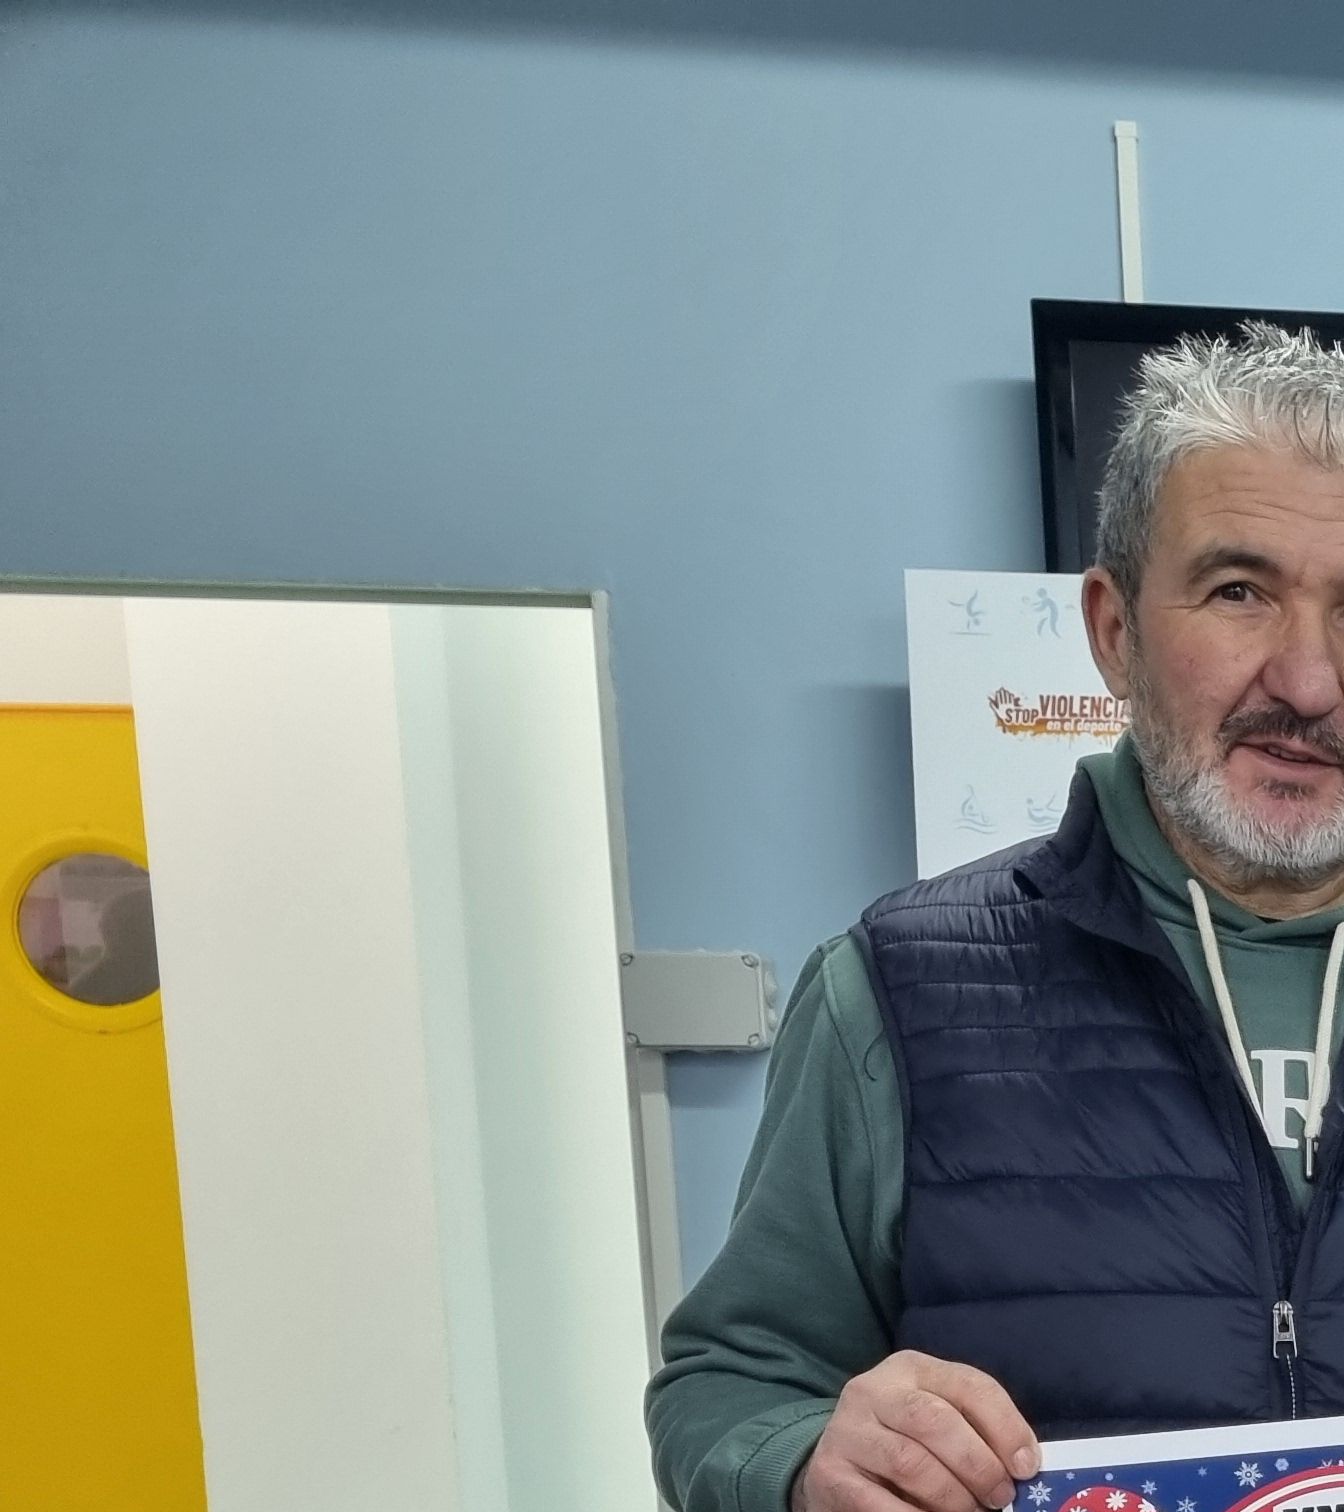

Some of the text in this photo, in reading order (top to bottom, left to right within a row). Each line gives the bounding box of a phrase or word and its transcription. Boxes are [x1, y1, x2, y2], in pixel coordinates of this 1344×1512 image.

[1005, 708, 1039, 724] STOP
[1046, 719, 1122, 735] en el deporte
